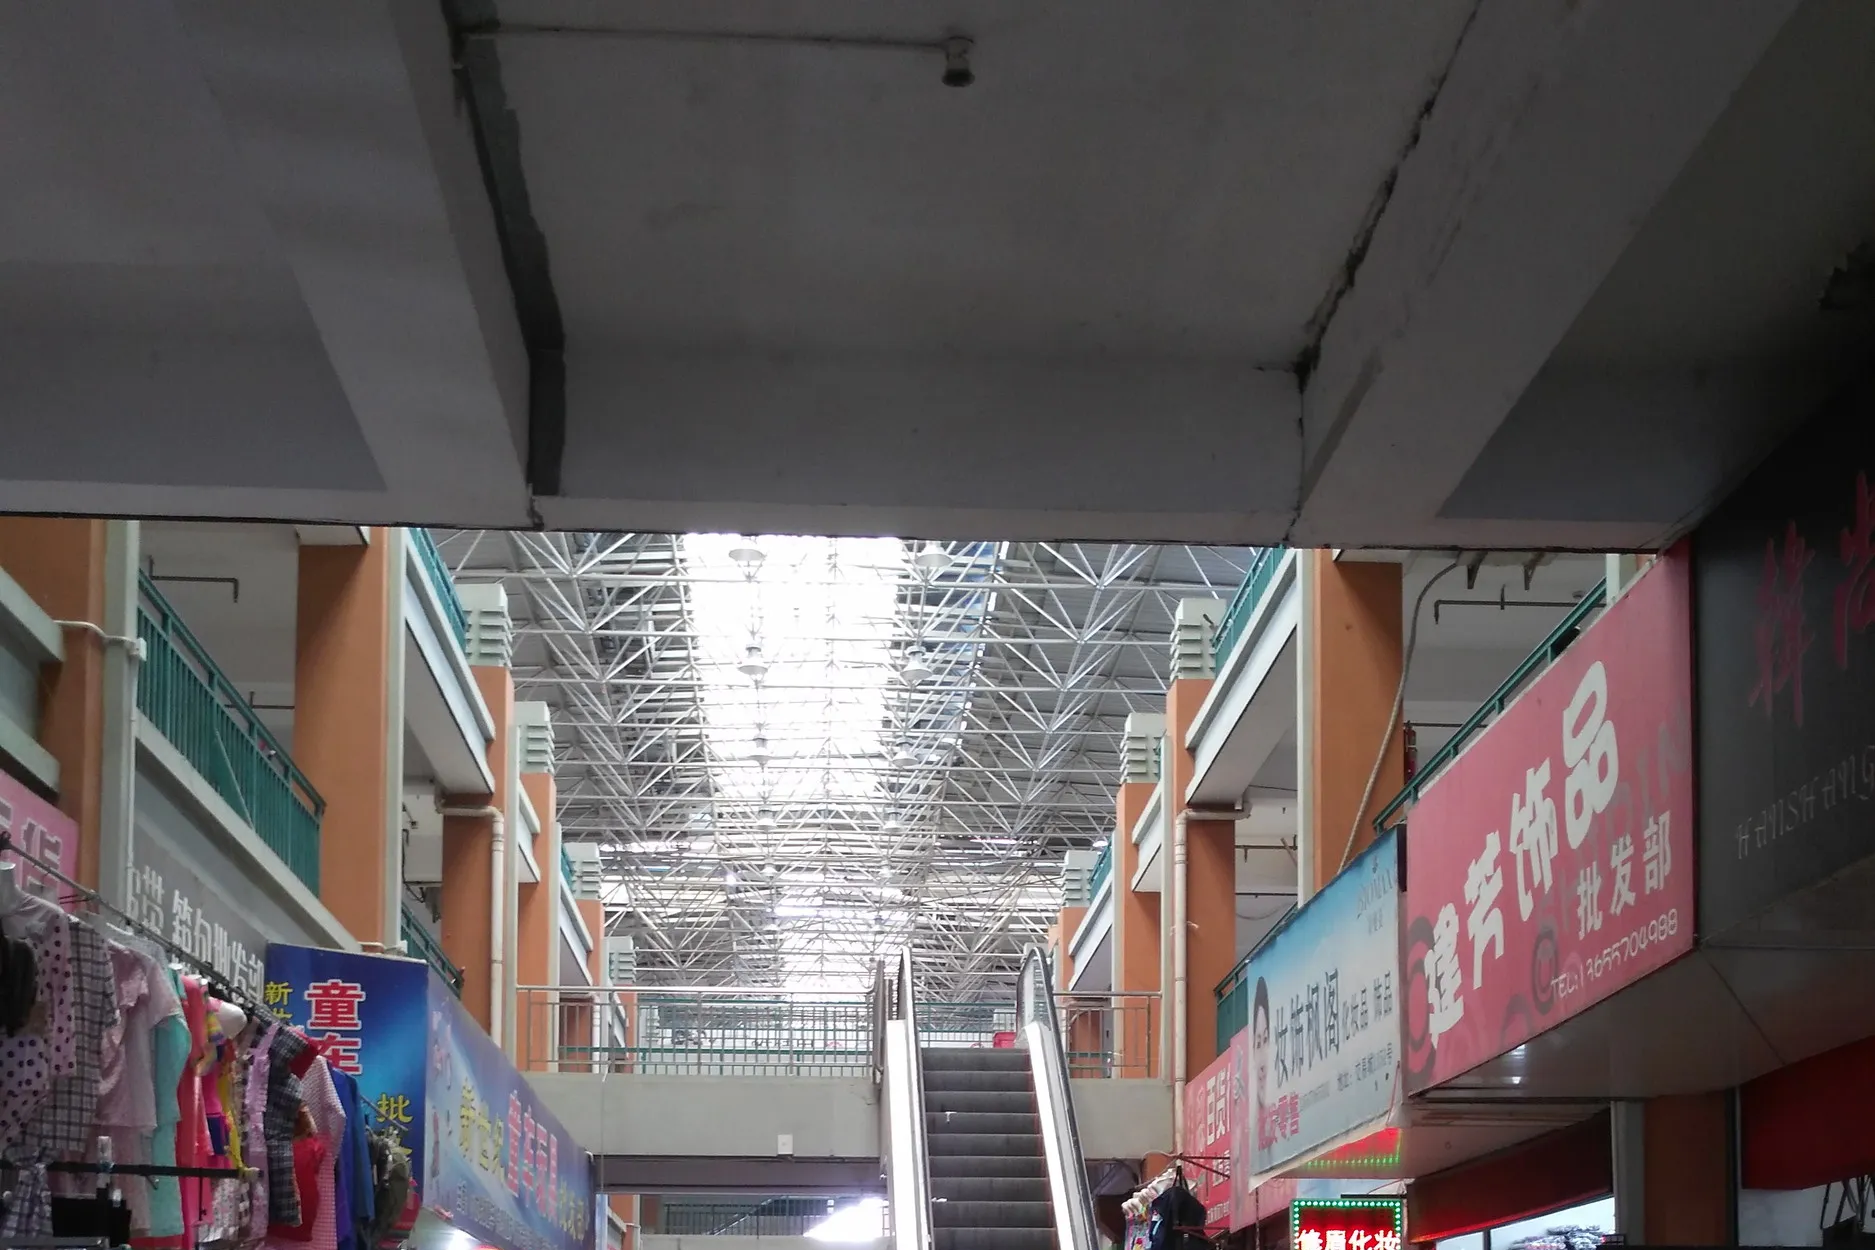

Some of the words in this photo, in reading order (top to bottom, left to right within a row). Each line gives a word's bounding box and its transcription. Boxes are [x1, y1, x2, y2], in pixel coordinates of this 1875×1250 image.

[1424, 660, 1619, 1048] 建芳饰品
[1576, 810, 1672, 941] 批发部
[1342, 987, 1369, 1044] 化妆品
